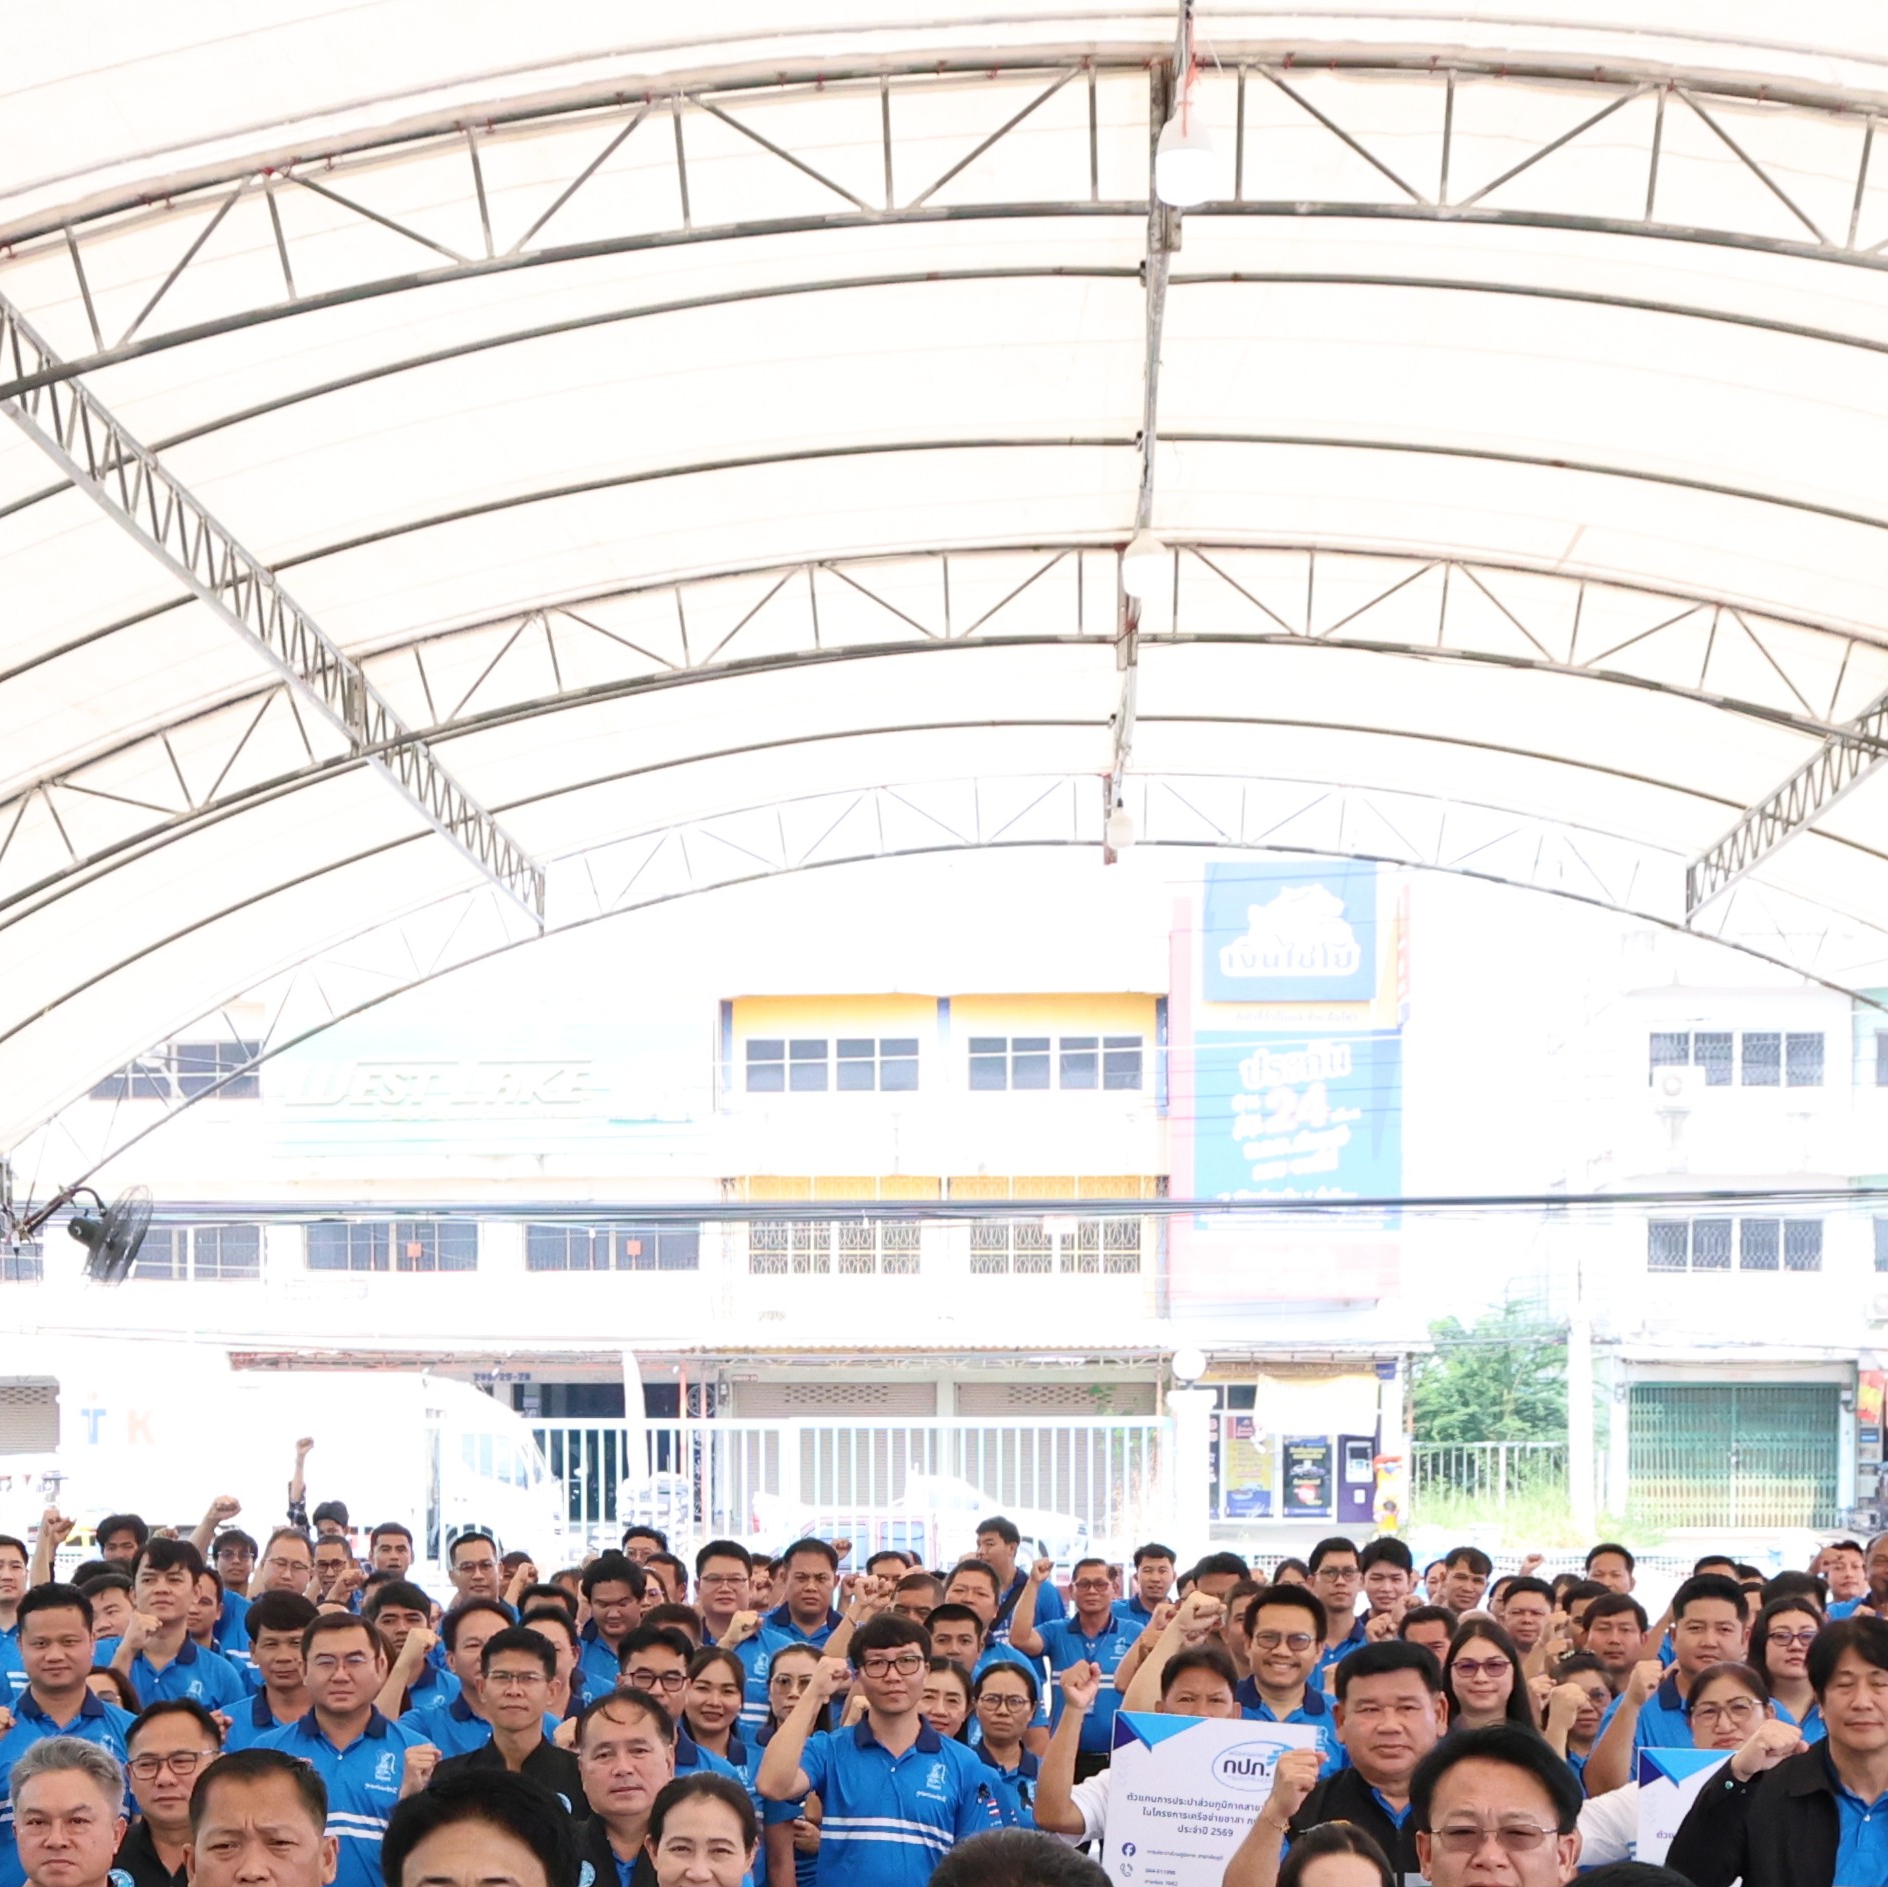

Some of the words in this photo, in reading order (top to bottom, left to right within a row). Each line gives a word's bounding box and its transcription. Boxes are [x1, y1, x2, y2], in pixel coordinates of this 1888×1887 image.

[1264, 1083, 1328, 1134] 24
[1223, 1758, 1271, 1777] กปภ.
[1126, 1792, 1265, 1812] ตัวแทนการประปาส่วนภูมิภาคสาขา
[1177, 1823, 1209, 1836] ประจำปี
[1210, 1827, 1234, 1838] 2569
